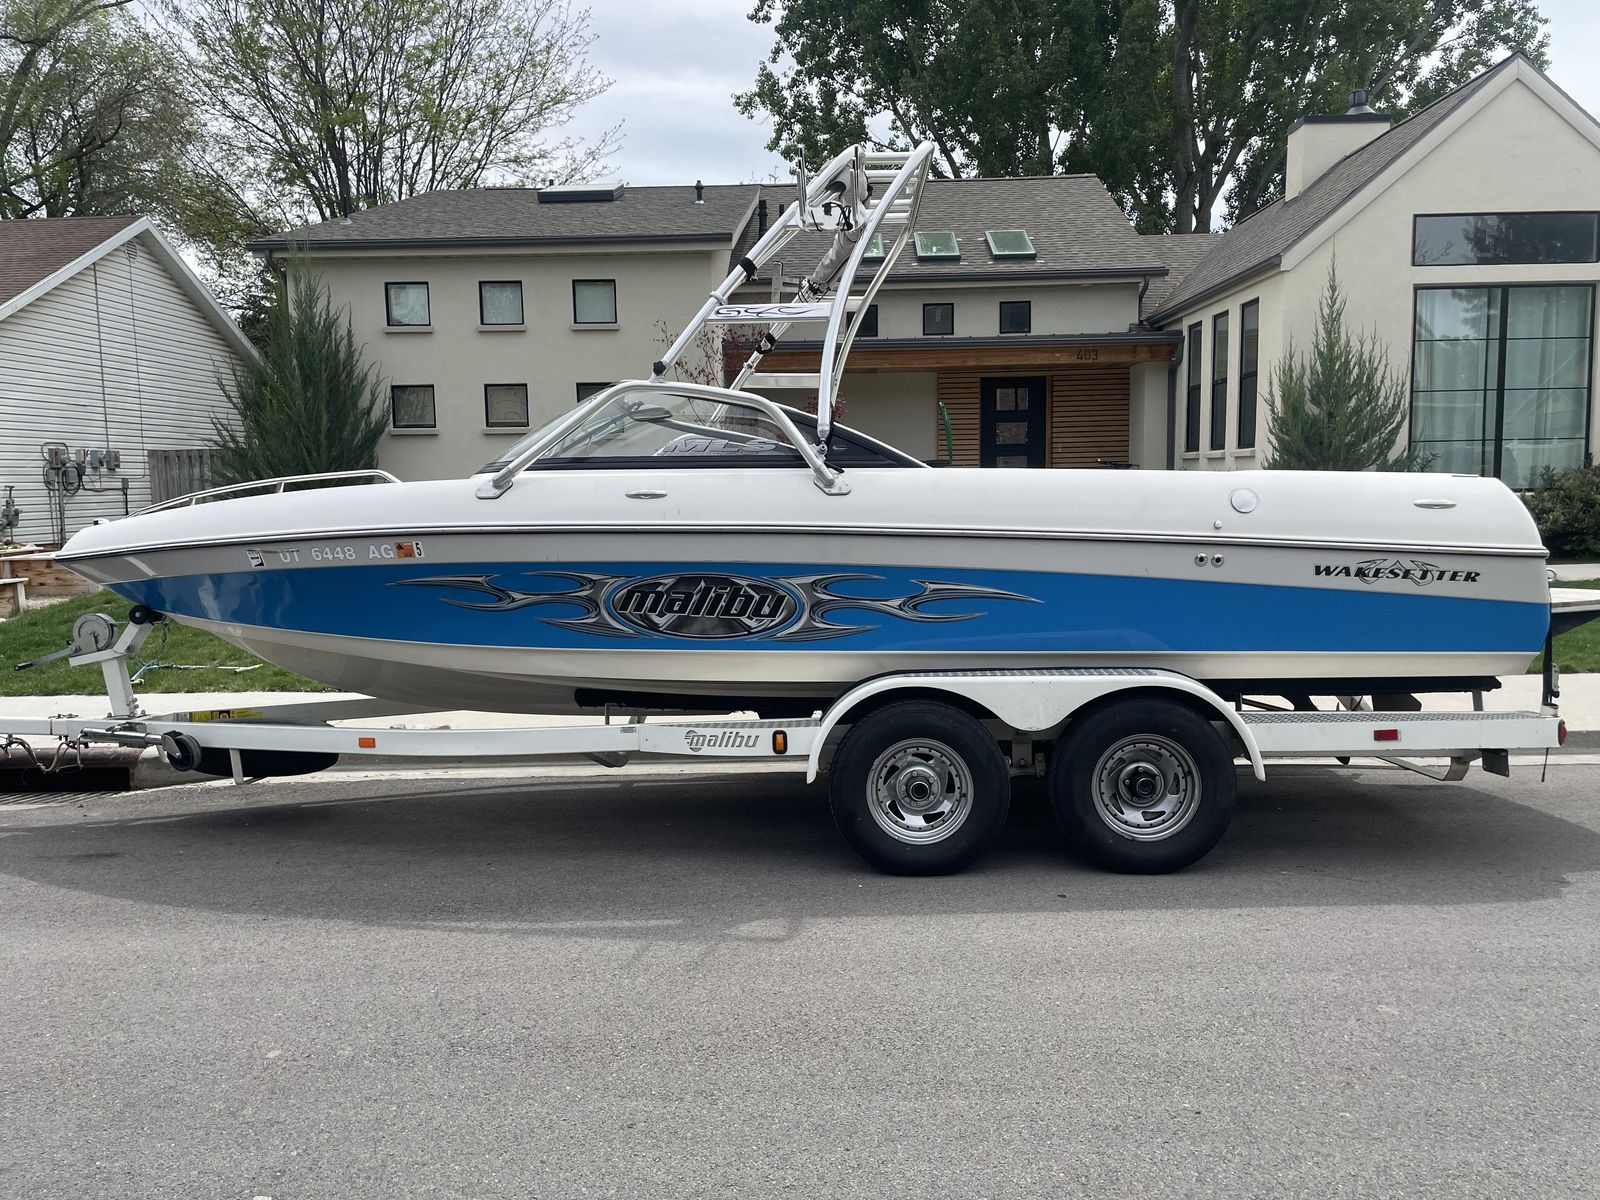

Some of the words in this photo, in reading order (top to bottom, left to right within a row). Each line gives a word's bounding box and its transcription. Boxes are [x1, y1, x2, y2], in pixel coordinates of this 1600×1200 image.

[279, 550, 300, 563] UT
[311, 547, 356, 561] 6448
[368, 544, 395, 559] AG
[1313, 564, 1481, 583] WAKESETTER
[616, 584, 787, 620] malibu
[689, 731, 760, 748] malibu
